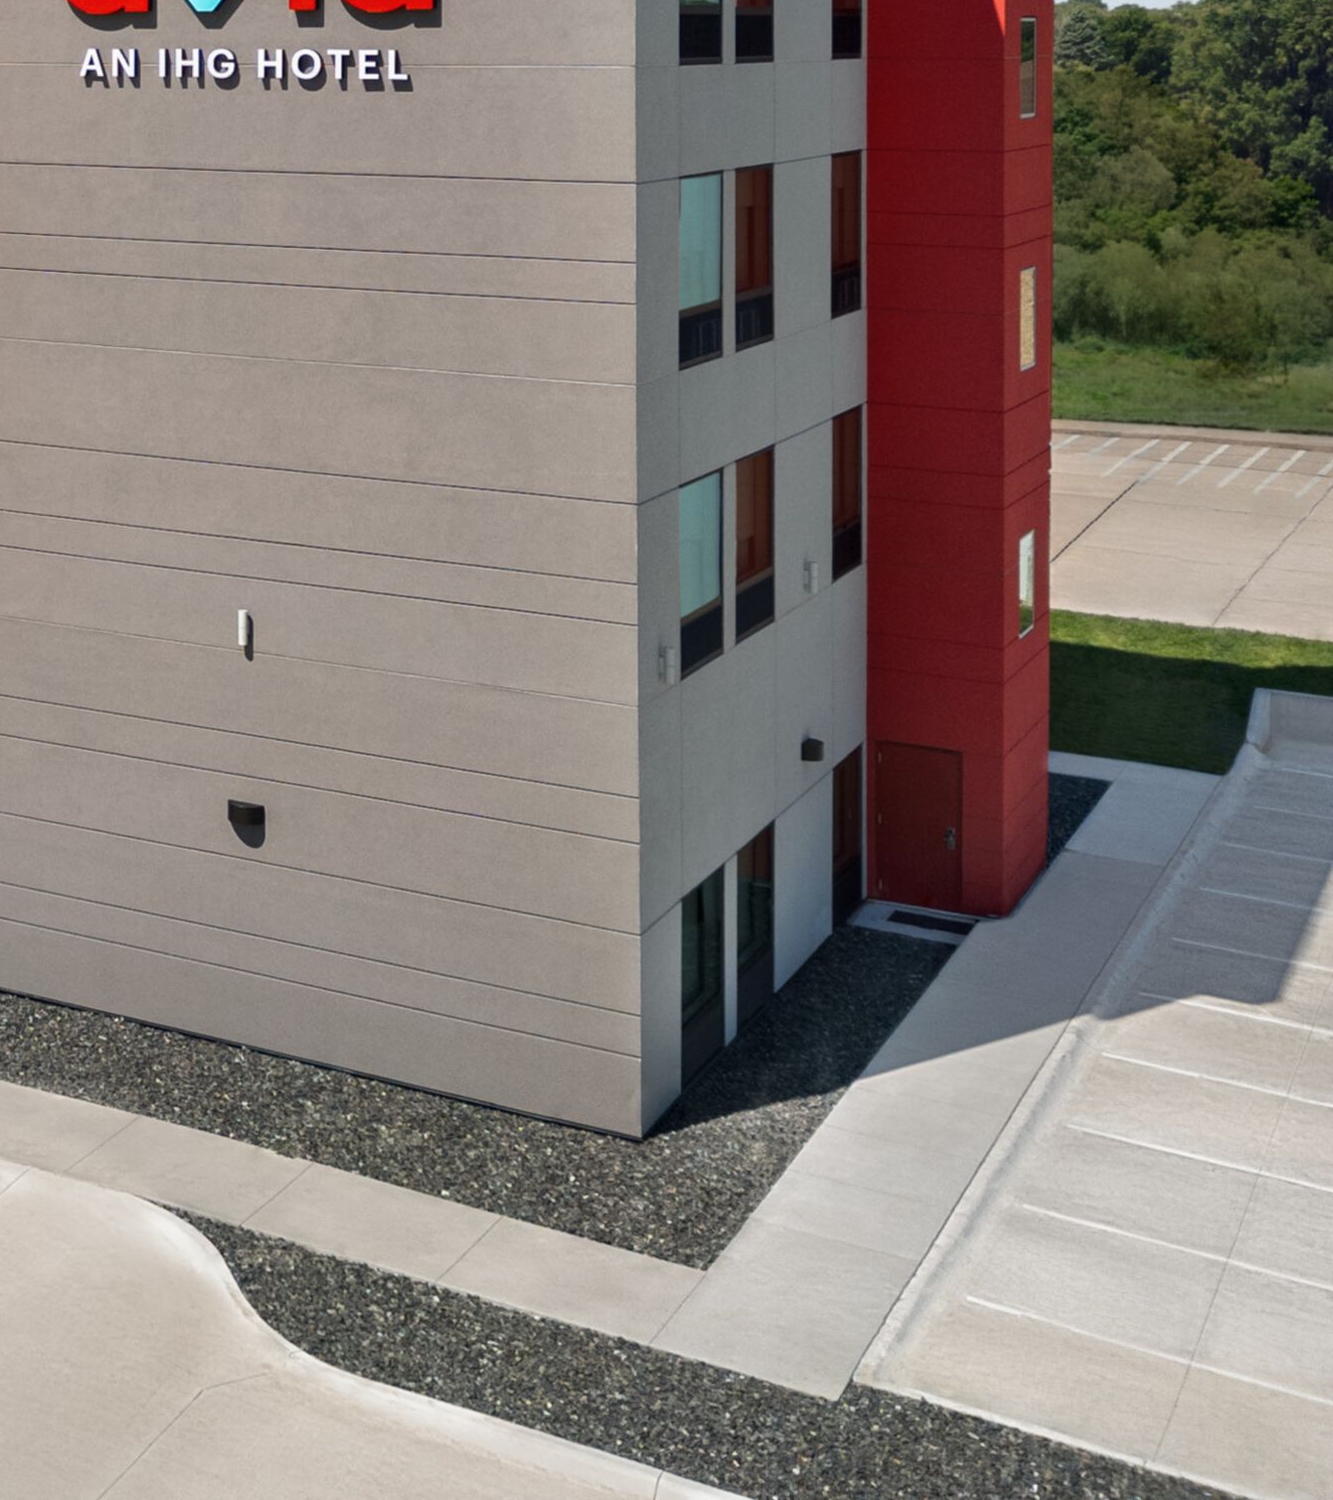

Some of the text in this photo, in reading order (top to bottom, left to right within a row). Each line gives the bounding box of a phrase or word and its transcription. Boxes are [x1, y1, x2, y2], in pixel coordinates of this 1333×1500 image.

[79, 47, 409, 81] AN IHG HOTEL
